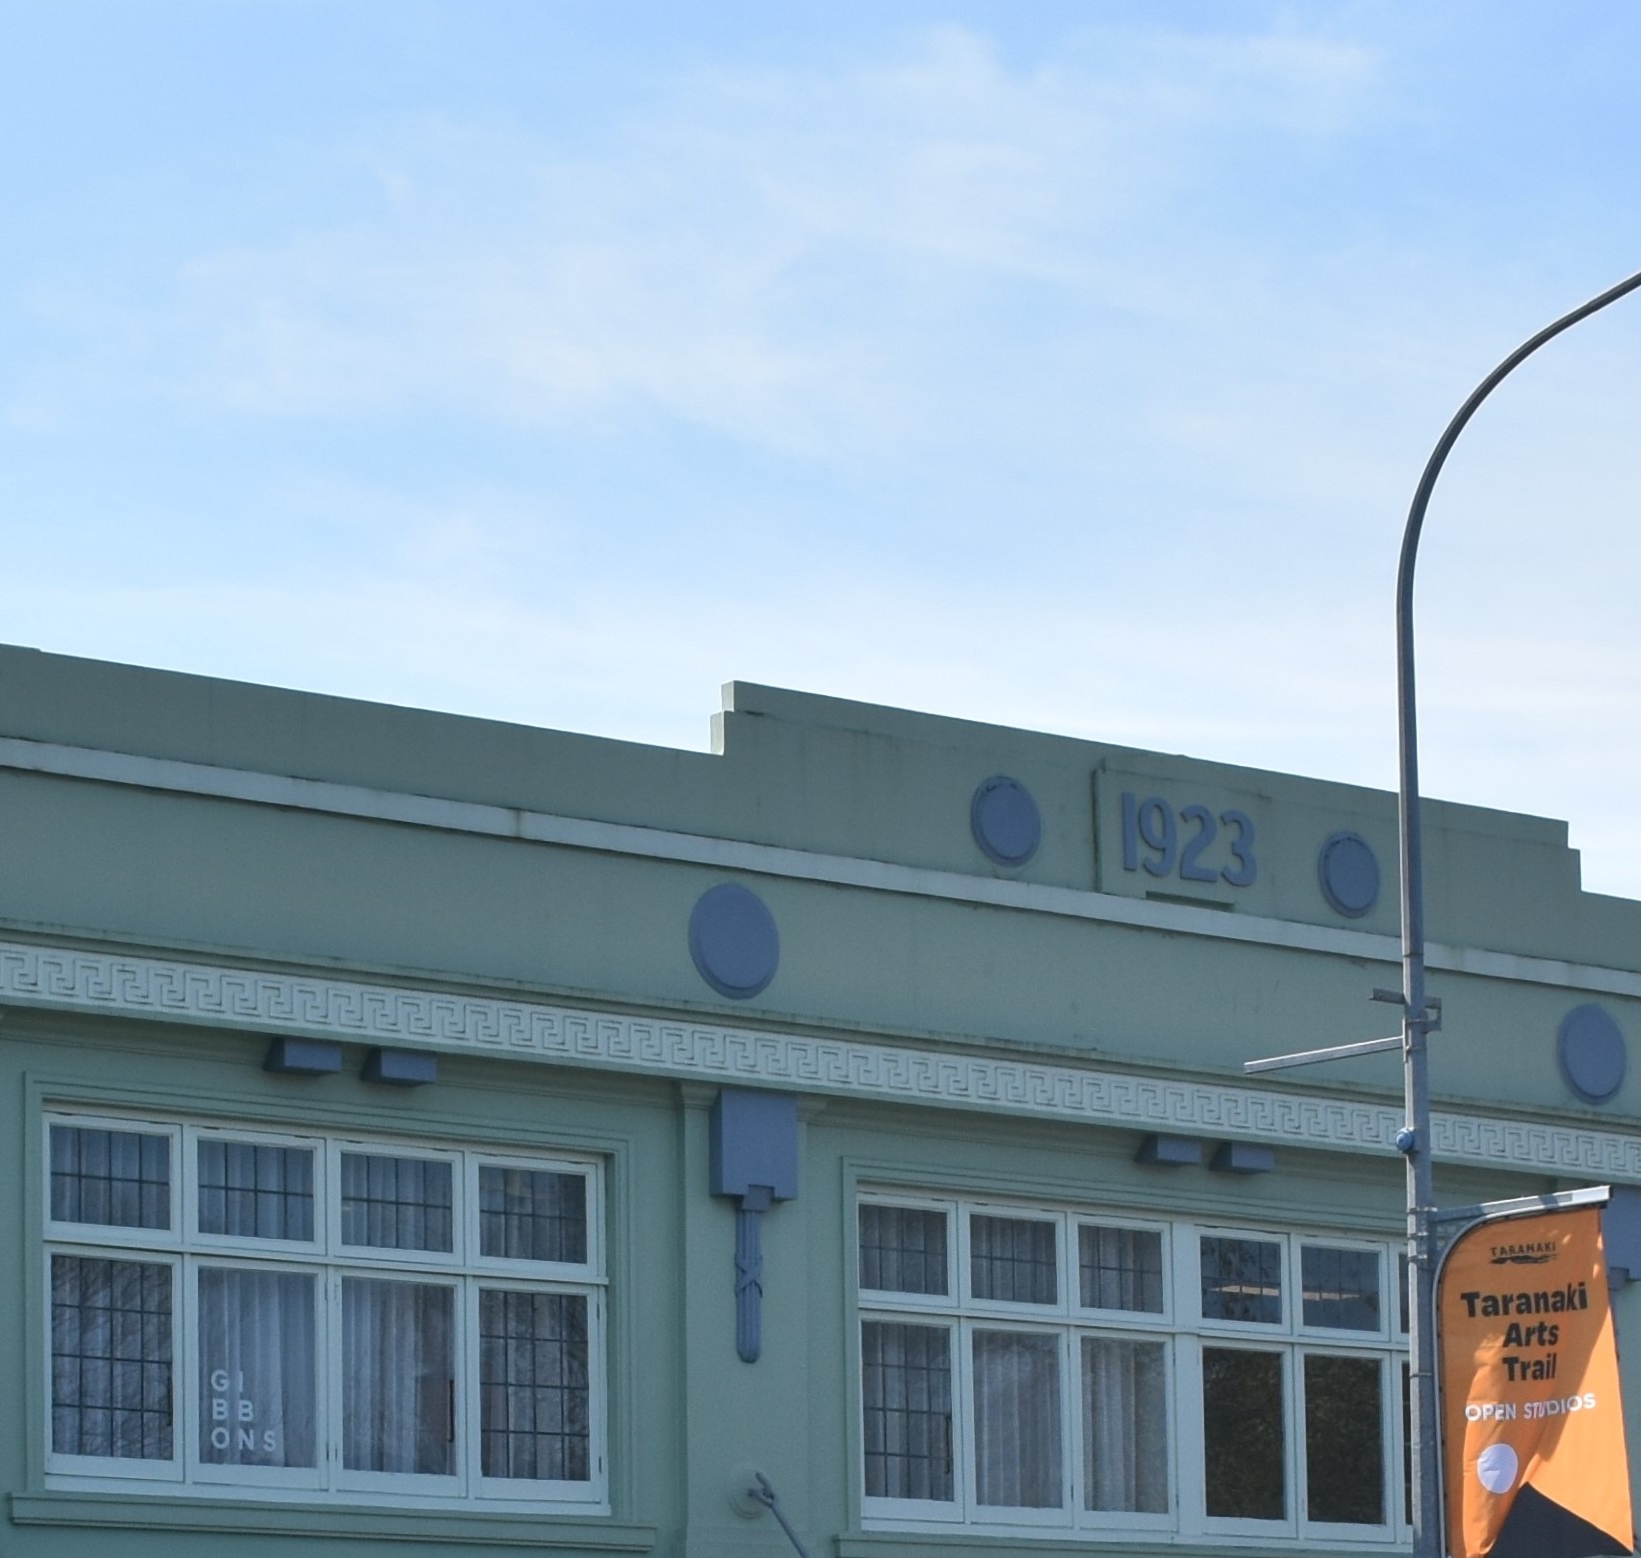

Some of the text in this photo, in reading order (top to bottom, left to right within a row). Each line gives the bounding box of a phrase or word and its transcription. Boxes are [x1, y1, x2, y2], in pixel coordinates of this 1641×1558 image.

[1122, 792, 1257, 887] 1923
[1491, 1242, 1556, 1256] TARANAKI
[1461, 1281, 1588, 1318] Taranaki
[1503, 1321, 1559, 1347] Arts
[1502, 1353, 1557, 1381] Trail
[1465, 1393, 1596, 1421] OPEN STUDIOS
